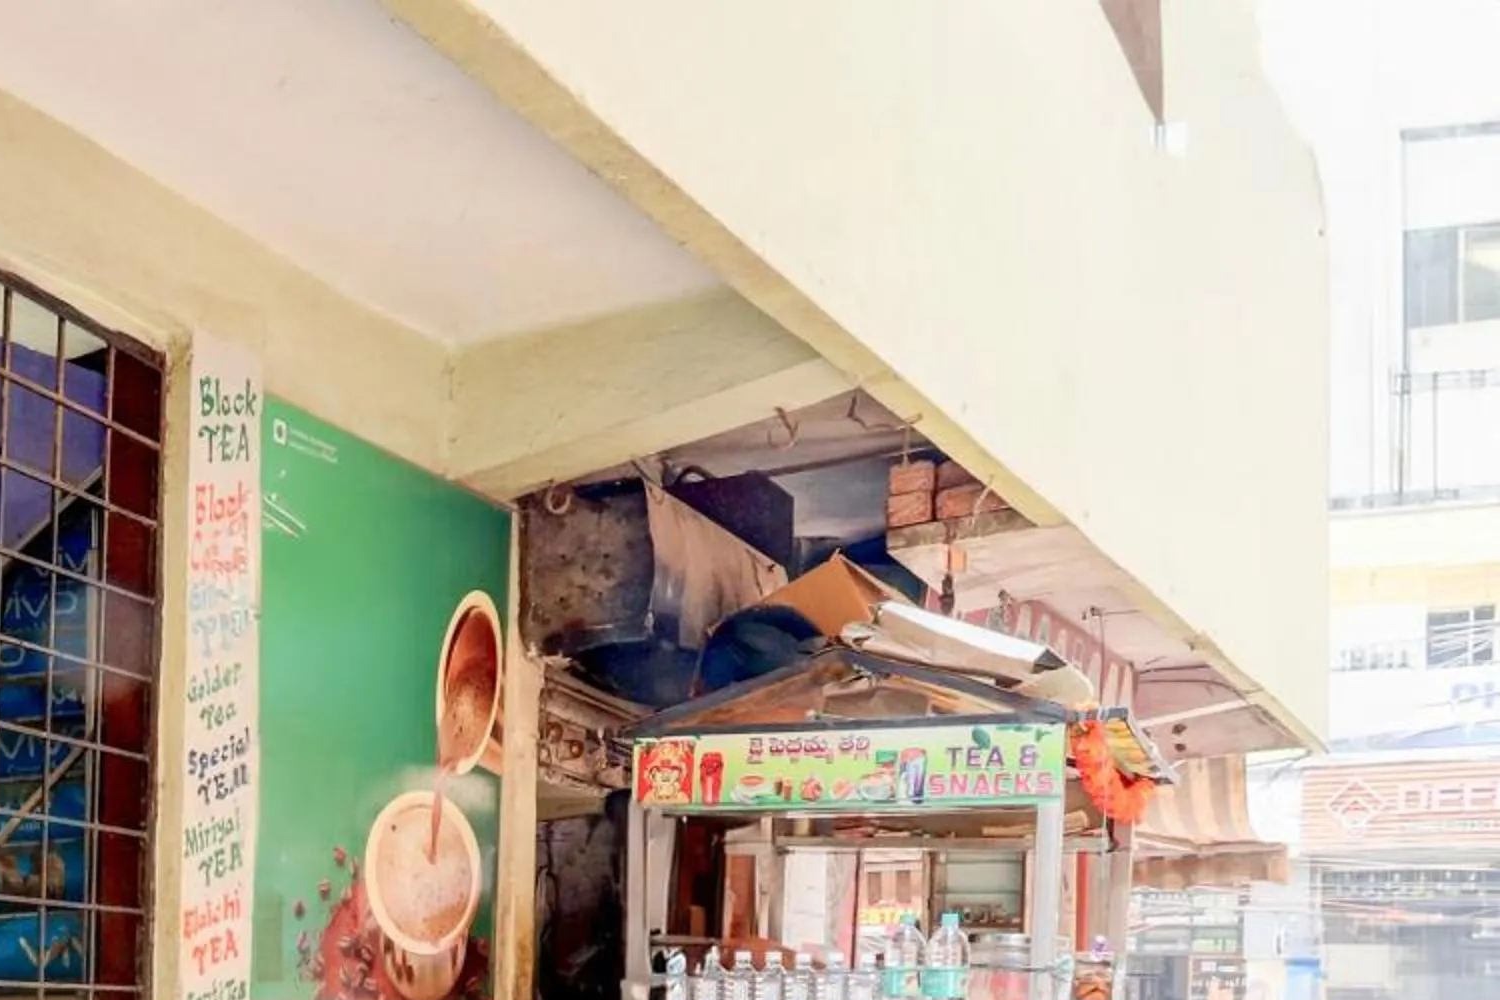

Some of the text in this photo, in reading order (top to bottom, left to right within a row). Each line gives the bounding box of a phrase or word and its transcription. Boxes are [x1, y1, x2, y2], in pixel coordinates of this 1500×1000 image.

[198, 423, 250, 464] TEA
[187, 725, 250, 779] Special
[946, 745, 1039, 768] TEA &
[928, 771, 1055, 796] SNACKS
[198, 842, 243, 887] TEA
[192, 928, 239, 976] TEA
